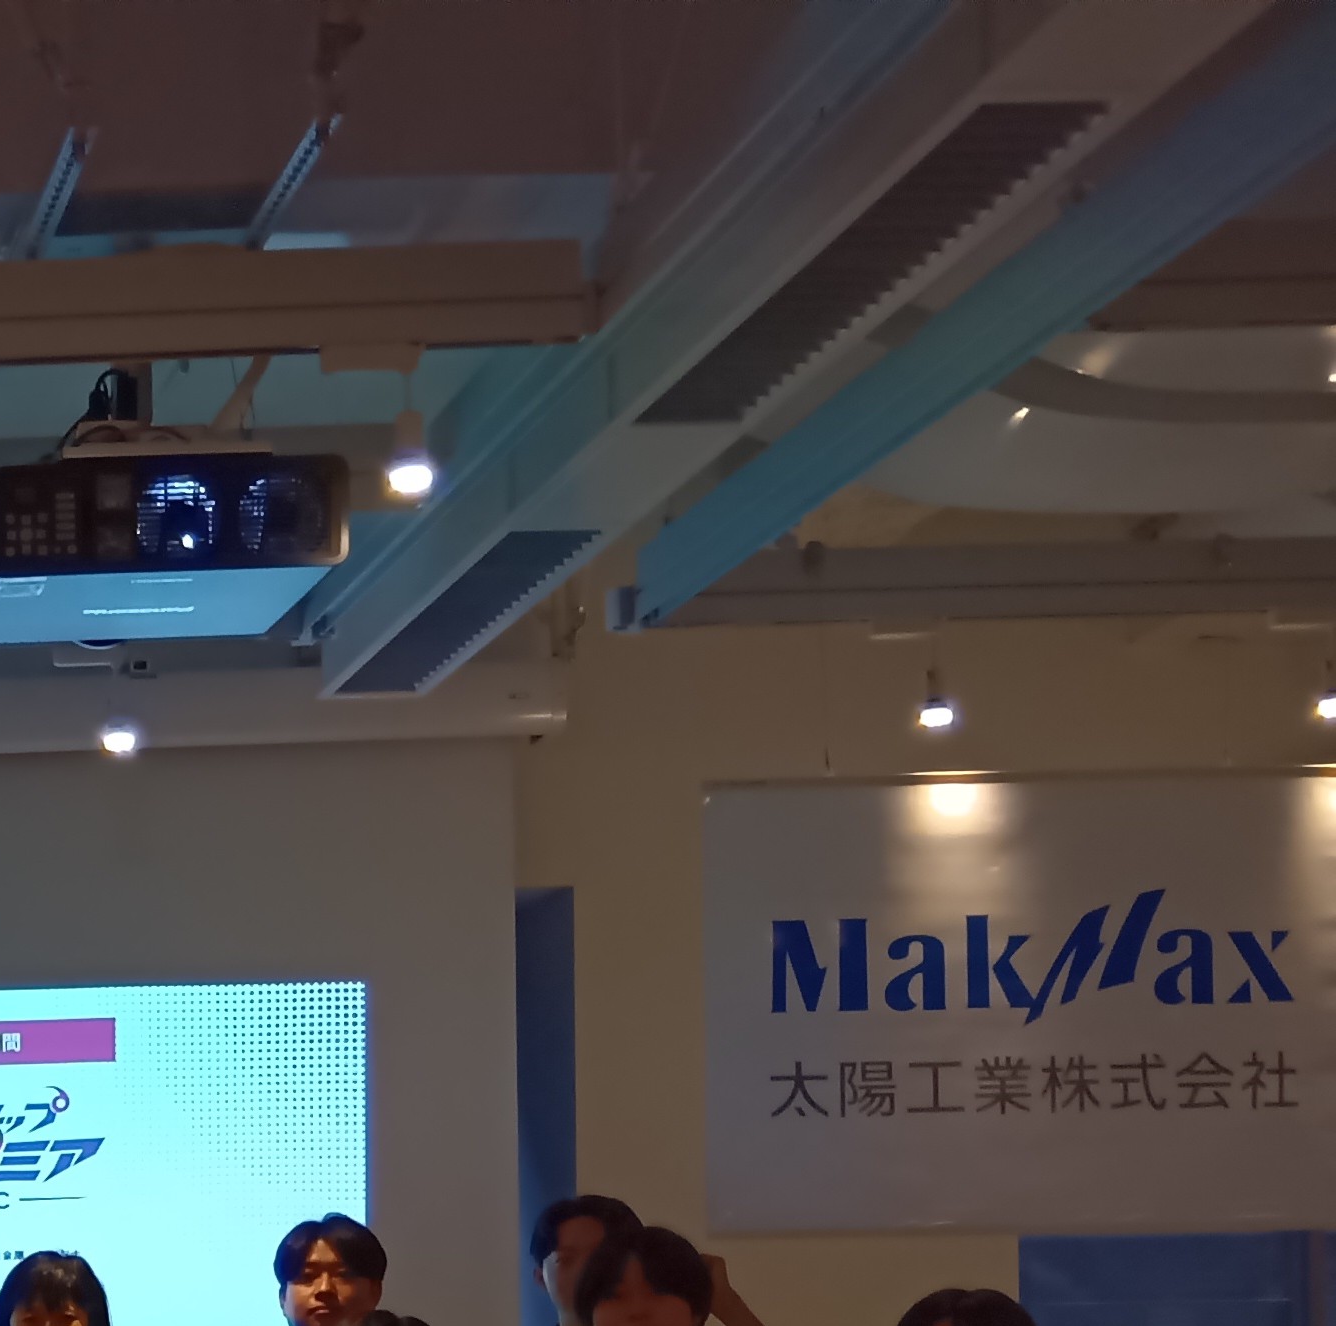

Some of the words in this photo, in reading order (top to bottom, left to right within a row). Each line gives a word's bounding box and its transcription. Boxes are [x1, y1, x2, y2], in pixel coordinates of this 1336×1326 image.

[771, 889, 1295, 1025] MakMax
[770, 1051, 1299, 1118] 太陽工業株式会社
